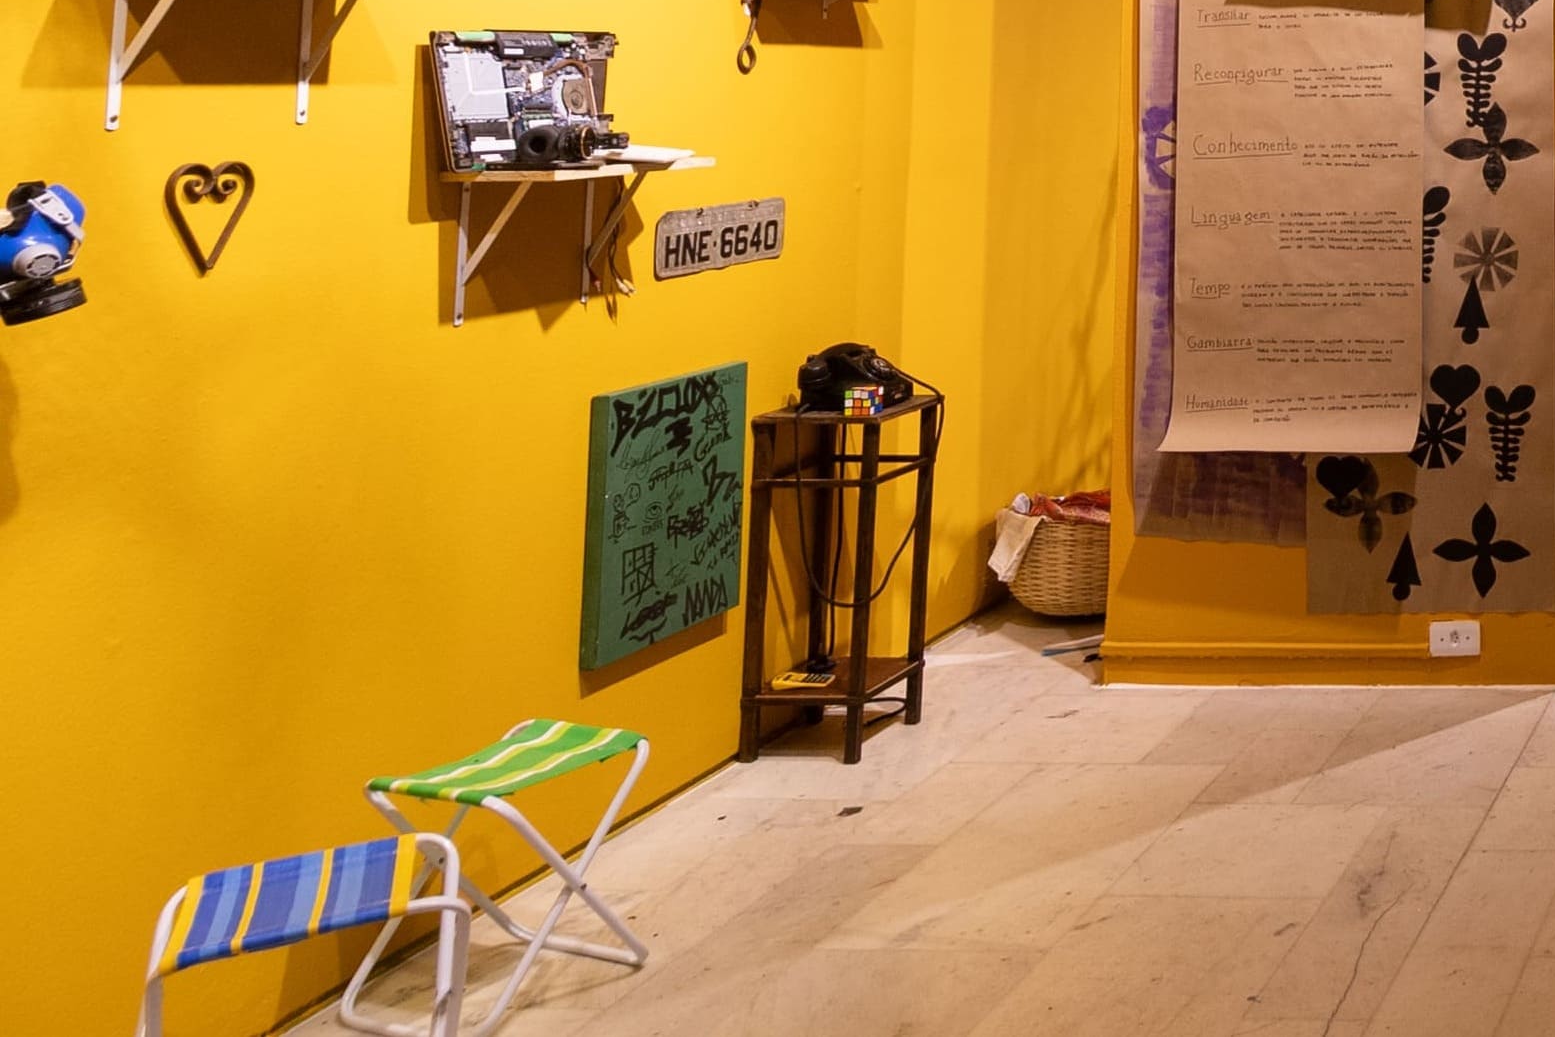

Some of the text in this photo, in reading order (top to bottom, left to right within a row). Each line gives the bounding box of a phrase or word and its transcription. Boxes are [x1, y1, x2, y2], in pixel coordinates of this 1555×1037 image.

[1194, 63, 1284, 85] Reconfigurar
[1193, 133, 1298, 155] Conhecimento
[1191, 205, 1271, 230] Linguagem
[1189, 277, 1230, 298] Tempo
[1187, 336, 1252, 349] Gambiarra
[1185, 394, 1249, 409] Humanidade
